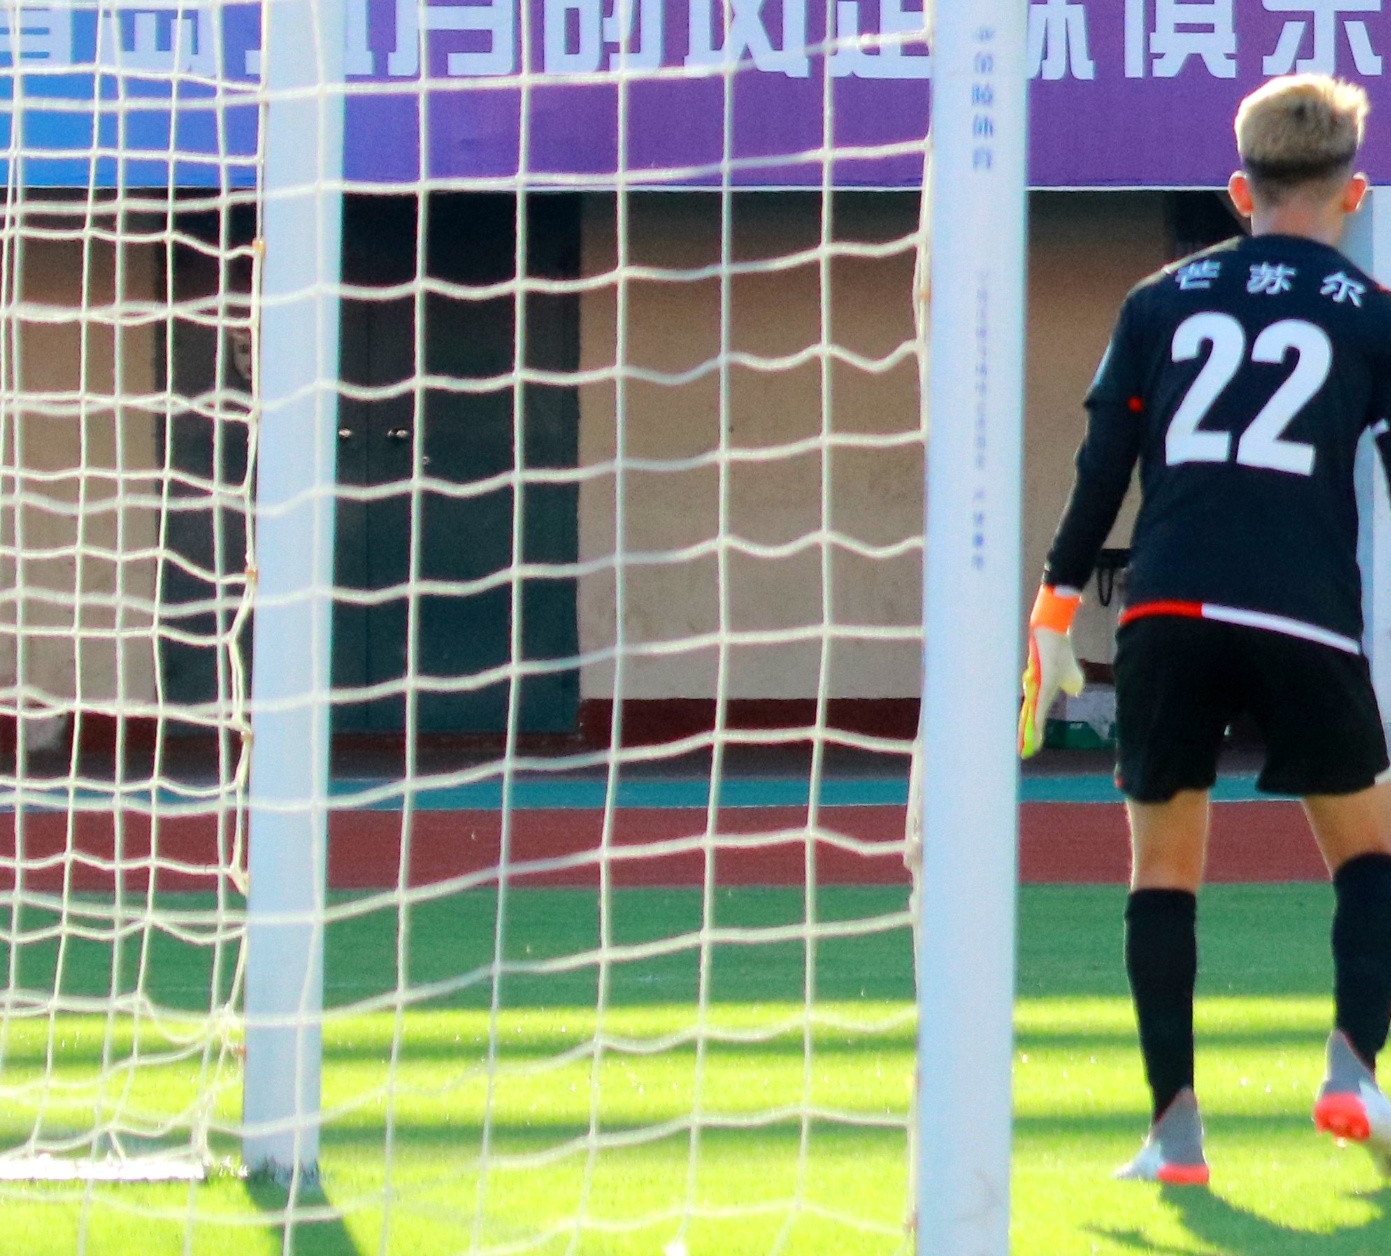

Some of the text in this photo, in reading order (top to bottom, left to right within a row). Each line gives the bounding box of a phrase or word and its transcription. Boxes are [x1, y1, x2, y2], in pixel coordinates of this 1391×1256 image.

[1175, 259, 1367, 308] 芒苏尔
[1165, 311, 1333, 476] 22
